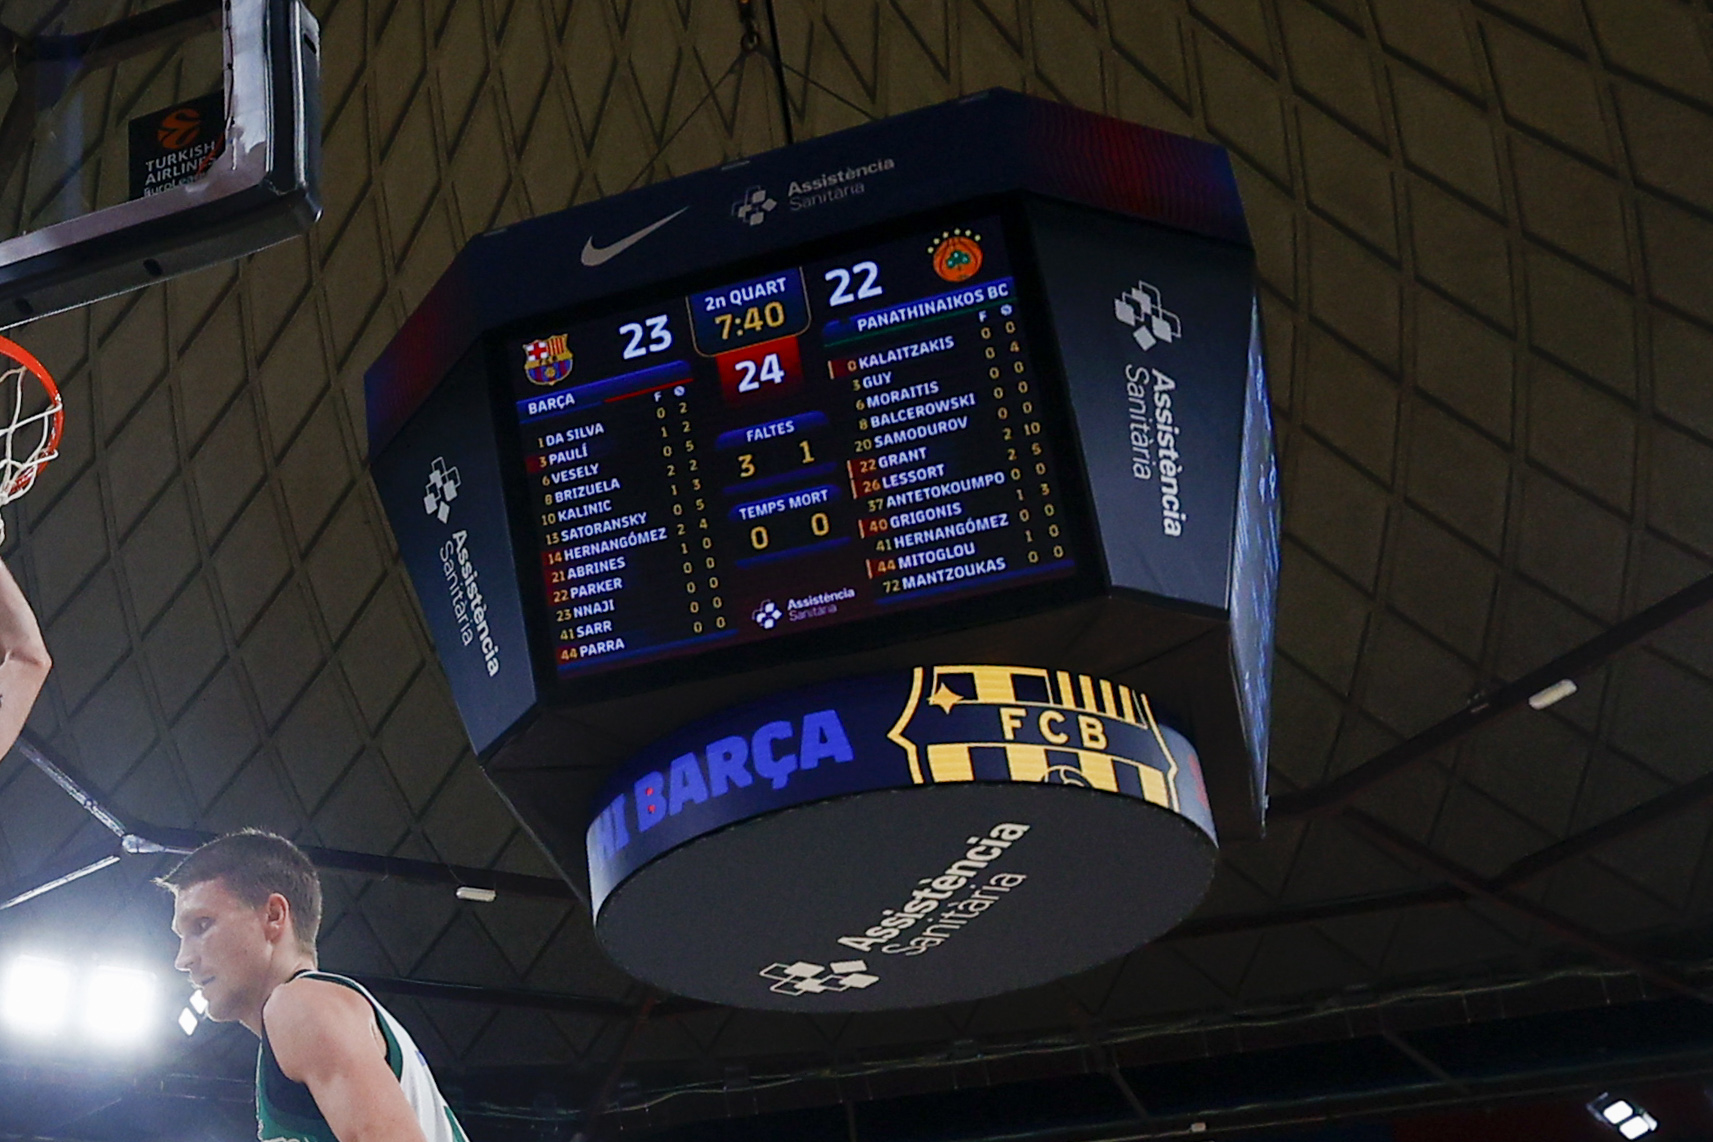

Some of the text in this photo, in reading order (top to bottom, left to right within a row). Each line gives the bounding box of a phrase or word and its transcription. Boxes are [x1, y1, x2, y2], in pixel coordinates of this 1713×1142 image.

[145, 141, 215, 171] TURKISH
[788, 158, 895, 196] Assistència
[789, 182, 865, 211] Sanitària
[704, 277, 787, 312] 2n QUART
[824, 260, 883, 307] 22
[714, 301, 786, 340] 7:40
[857, 283, 1009, 332] PANATHINAIKOS BC
[978, 311, 987, 322] F
[619, 314, 673, 359] 23
[847, 321, 1016, 372] 0 KALAITZAKIS 0 0
[734, 353, 785, 393] 24
[852, 341, 1019, 391] 3 GUY 0 4
[856, 361, 1024, 411] 6 MORAITIS 0 0
[527, 393, 575, 415] BARÇA
[654, 391, 662, 402] F
[859, 381, 1028, 430] 8 BALCEROWSKI 0 0
[538, 402, 688, 448] 1 DA SILVA 0 2
[539, 421, 691, 468] 3 PAULÍ 1 2
[746, 420, 795, 442] FALTES
[854, 401, 1033, 452] 20 SAMODUROV 0 0
[1125, 364, 1156, 480] Sanitària
[542, 440, 694, 486] 6 VESELY 0 5
[738, 440, 815, 478] 3 1
[859, 422, 1041, 473] 22 GRANT 2 10
[862, 443, 1042, 493] 26 LESSORT 2 5
[1151, 368, 1187, 537] Assistència
[542, 479, 701, 526] 10 KALINIC 1 3
[545, 459, 698, 505] 8 BRIZUELA 2 2
[739, 489, 828, 520] TEMPS MORT
[867, 462, 1046, 512] 37 ANTETOKOUMPO 0 0
[545, 498, 705, 545] 13 SATORANSKY 0 5
[869, 483, 1050, 532] 40 GRIGONIS 1 3
[548, 518, 708, 565] 14 HERNANGÓMEZ 2 4
[750, 512, 830, 550] 0 0
[876, 513, 1009, 552] 41 HERNANGÓMEZ
[877, 524, 1059, 572] 44 MITOGLOU 1 0
[552, 537, 711, 583] 21 ABRINES 1 0
[883, 557, 1006, 593] 72 MANTZOUKAS
[439, 540, 474, 646] Sanitària
[452, 529, 499, 677] Assistència
[553, 577, 623, 603] 22 PARKER
[556, 599, 615, 622] 23 NNAJI
[787, 587, 855, 610] Assistència
[560, 620, 613, 640] 41 SARR
[561, 638, 625, 660] 44 PARRA
[999, 706, 1108, 750] FCB
[634, 709, 854, 833] BARÇA
[837, 822, 1030, 952] Assistència
[881, 872, 1027, 956] Sanitària
